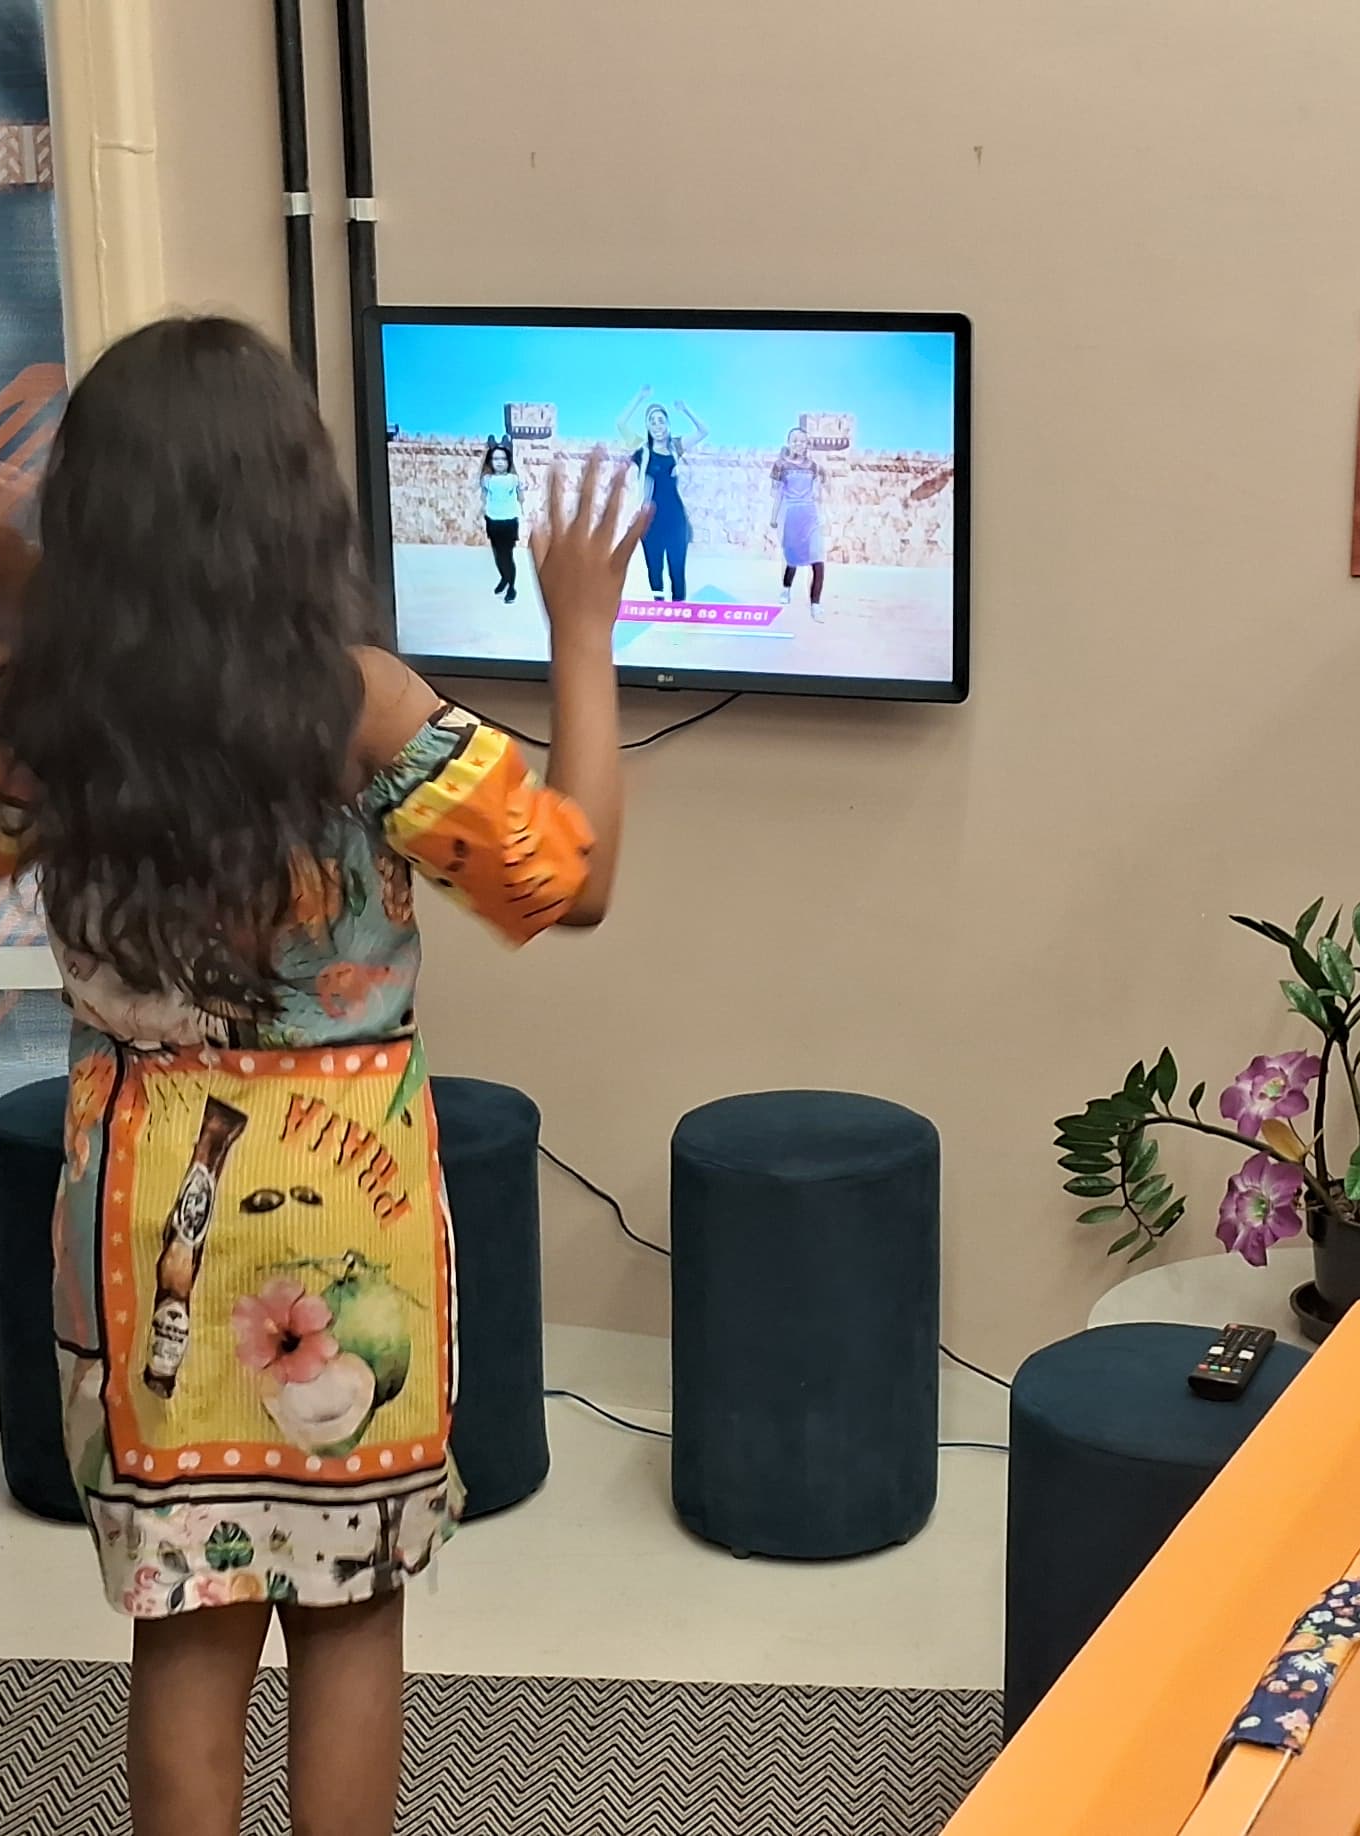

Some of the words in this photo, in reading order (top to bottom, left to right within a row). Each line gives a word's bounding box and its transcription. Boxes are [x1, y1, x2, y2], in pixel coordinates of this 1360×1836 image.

[697, 609, 718, 619] no
[724, 610, 769, 621] canal
[279, 1092, 412, 1230] PRAIA
